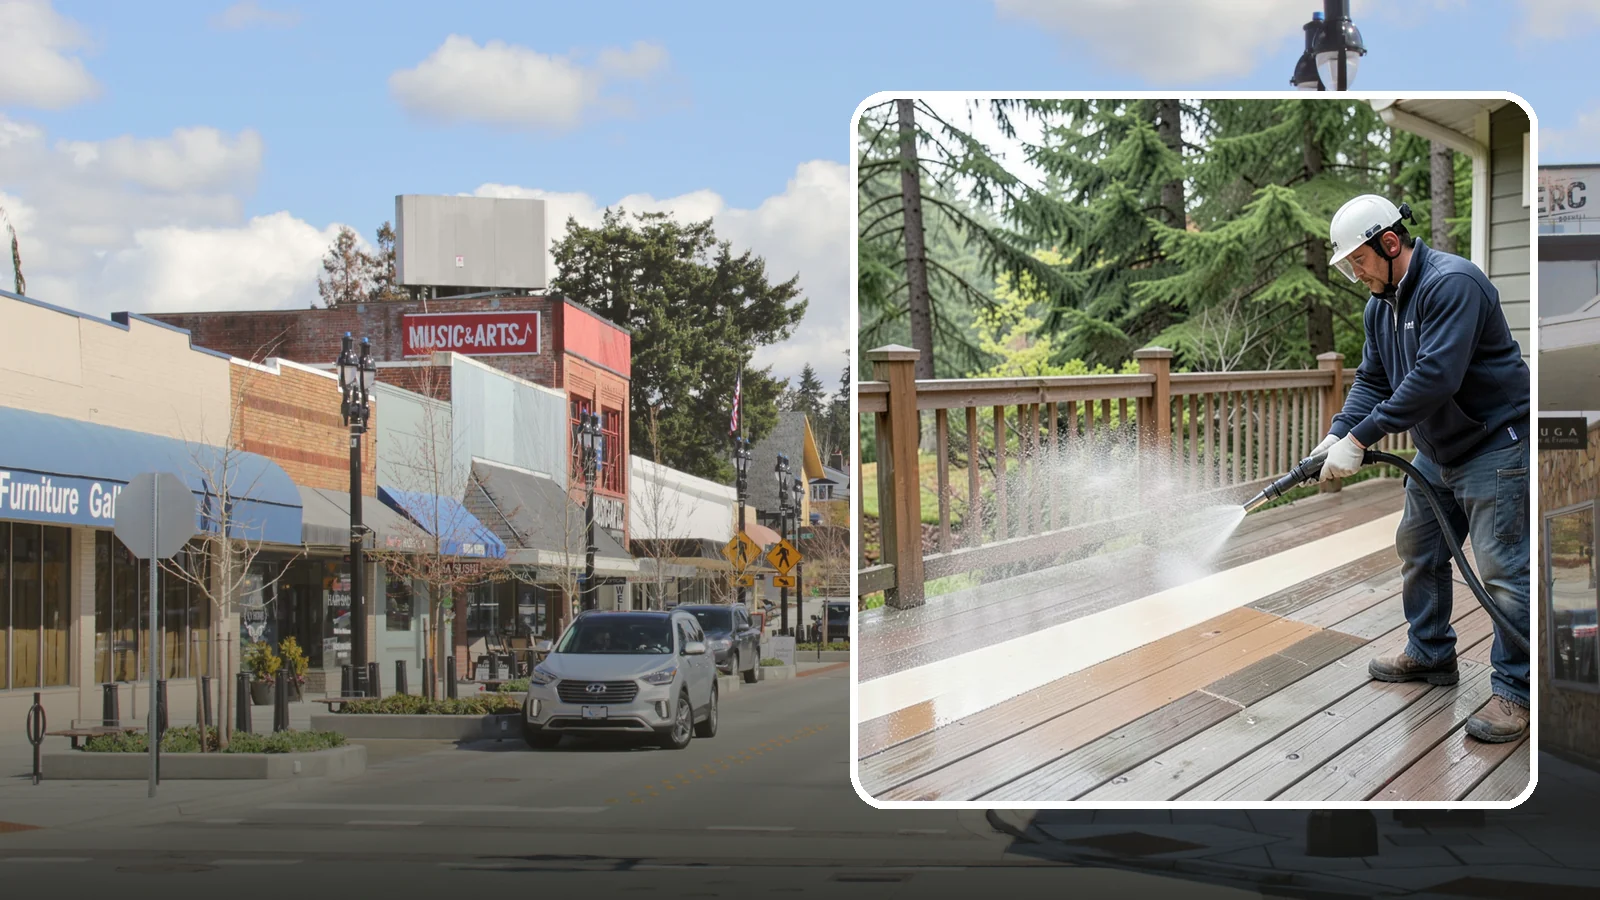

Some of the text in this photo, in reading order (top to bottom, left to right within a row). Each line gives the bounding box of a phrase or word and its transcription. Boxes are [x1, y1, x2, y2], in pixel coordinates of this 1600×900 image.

[409, 323, 520, 349] MUSIC&ARTS
[0, 471, 122, 519] Furniture Gal
[453, 563, 479, 574] SUSHI
